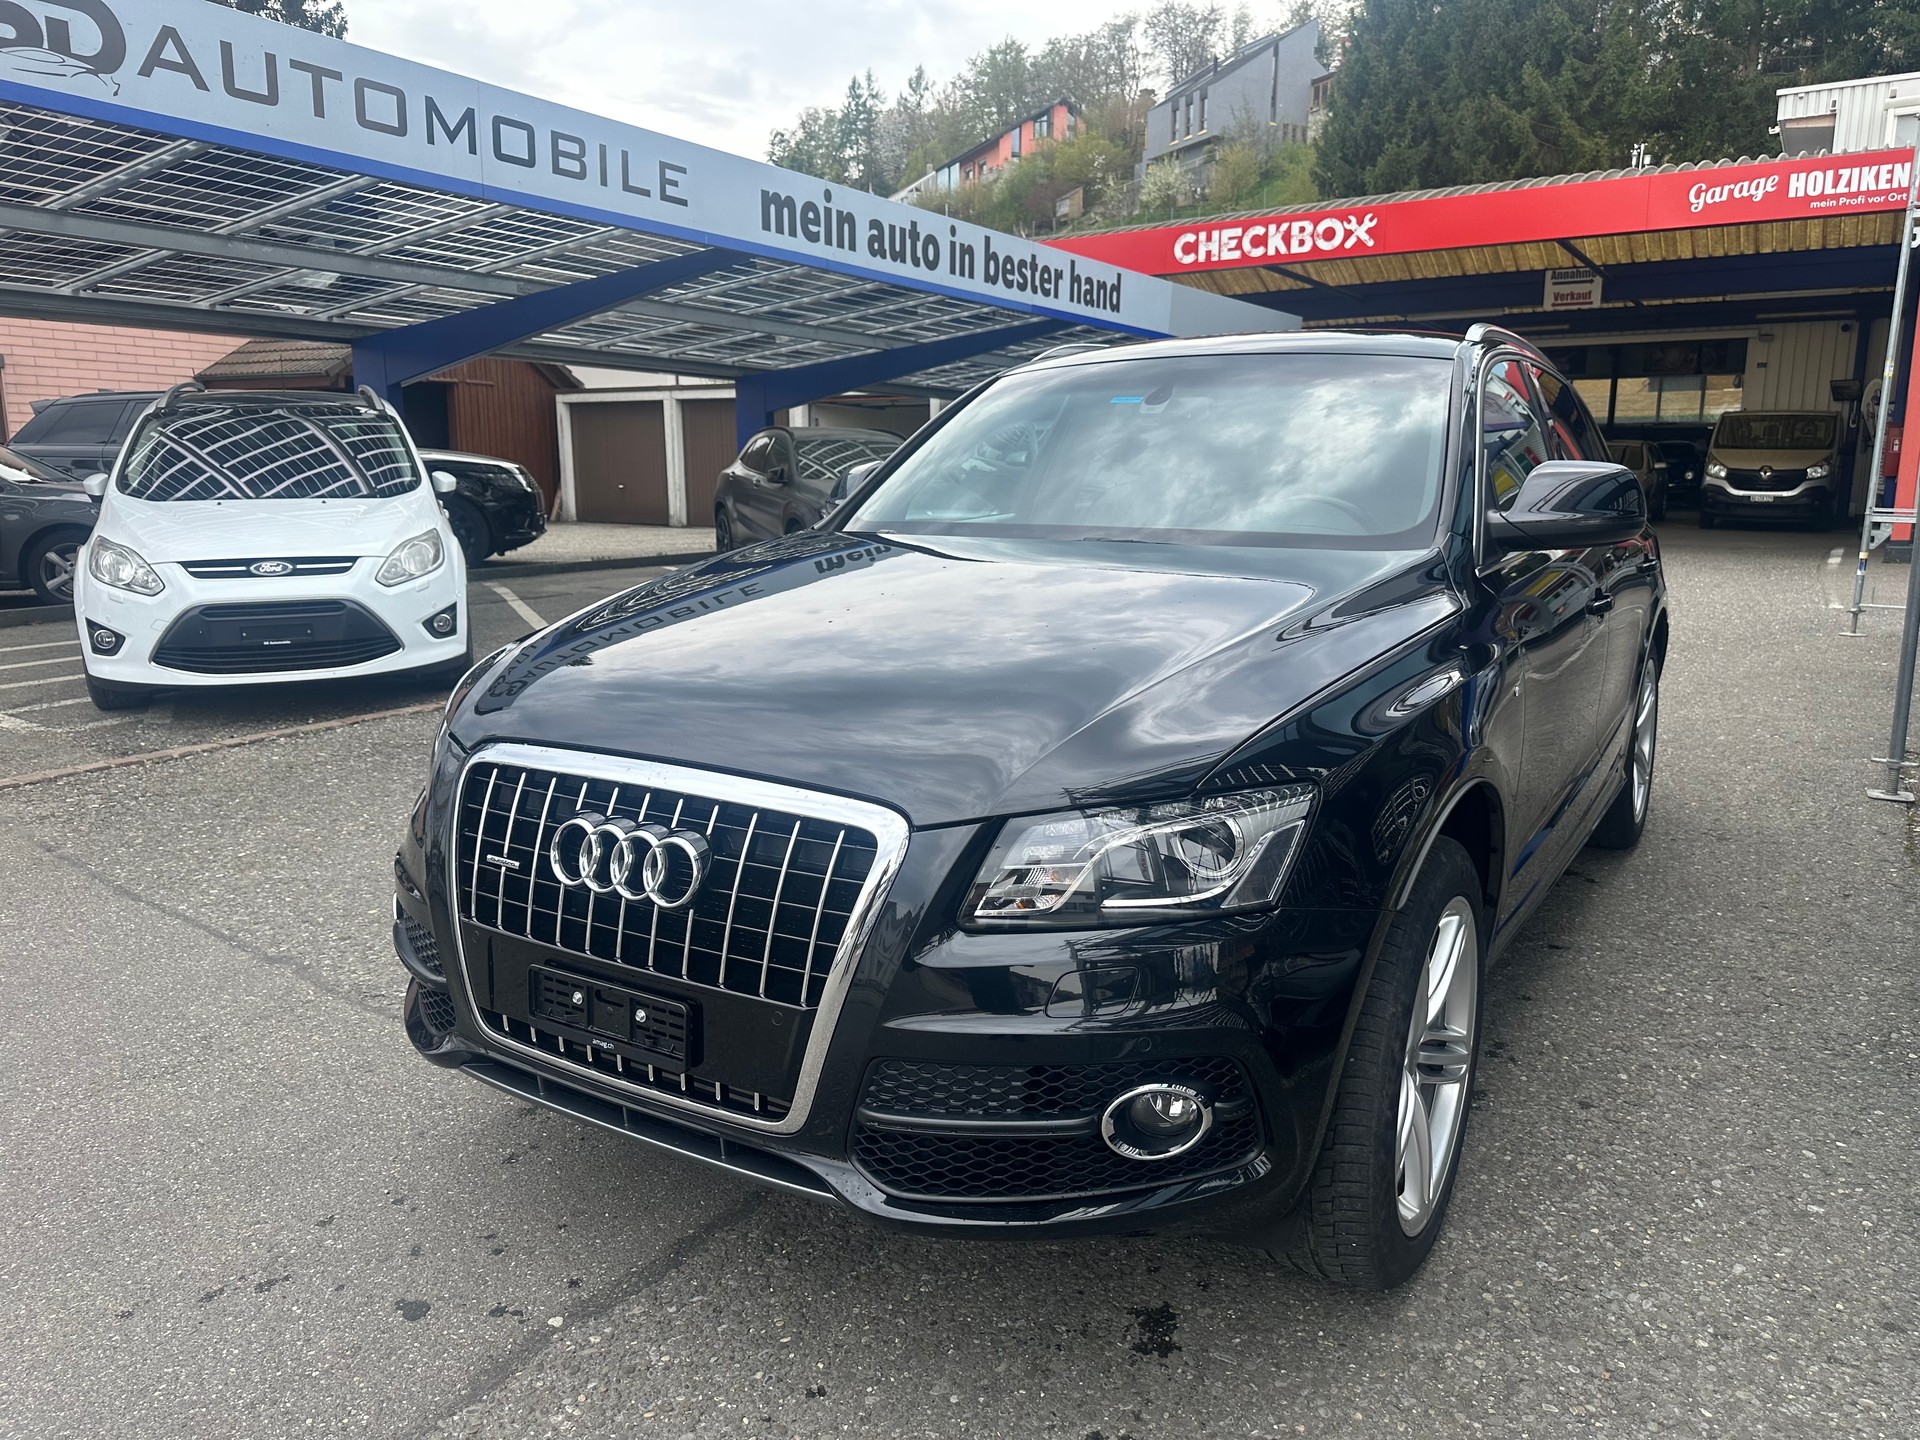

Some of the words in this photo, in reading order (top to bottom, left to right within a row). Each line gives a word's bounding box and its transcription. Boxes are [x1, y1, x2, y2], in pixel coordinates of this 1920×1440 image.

[138, 25, 689, 207] AUTOMOBILE
[1688, 174, 1779, 213] Garage
[1788, 162, 1911, 198] HOLZIKEN
[1810, 198, 1837, 209] mein
[1839, 195, 1865, 206] Profi
[1867, 195, 1886, 204] vor
[1888, 192, 1907, 201] Ort
[761, 189, 856, 252] mein
[868, 219, 940, 270] auto
[949, 225, 974, 279] in
[984, 236, 1063, 300] bester
[1069, 260, 1122, 313] hand
[1173, 213, 1378, 265] CHECKBOX
[1553, 290, 1592, 302] Verkauf
[259, 562, 283, 573] Ford
[592, 1038, 615, 1050] amag.ch
